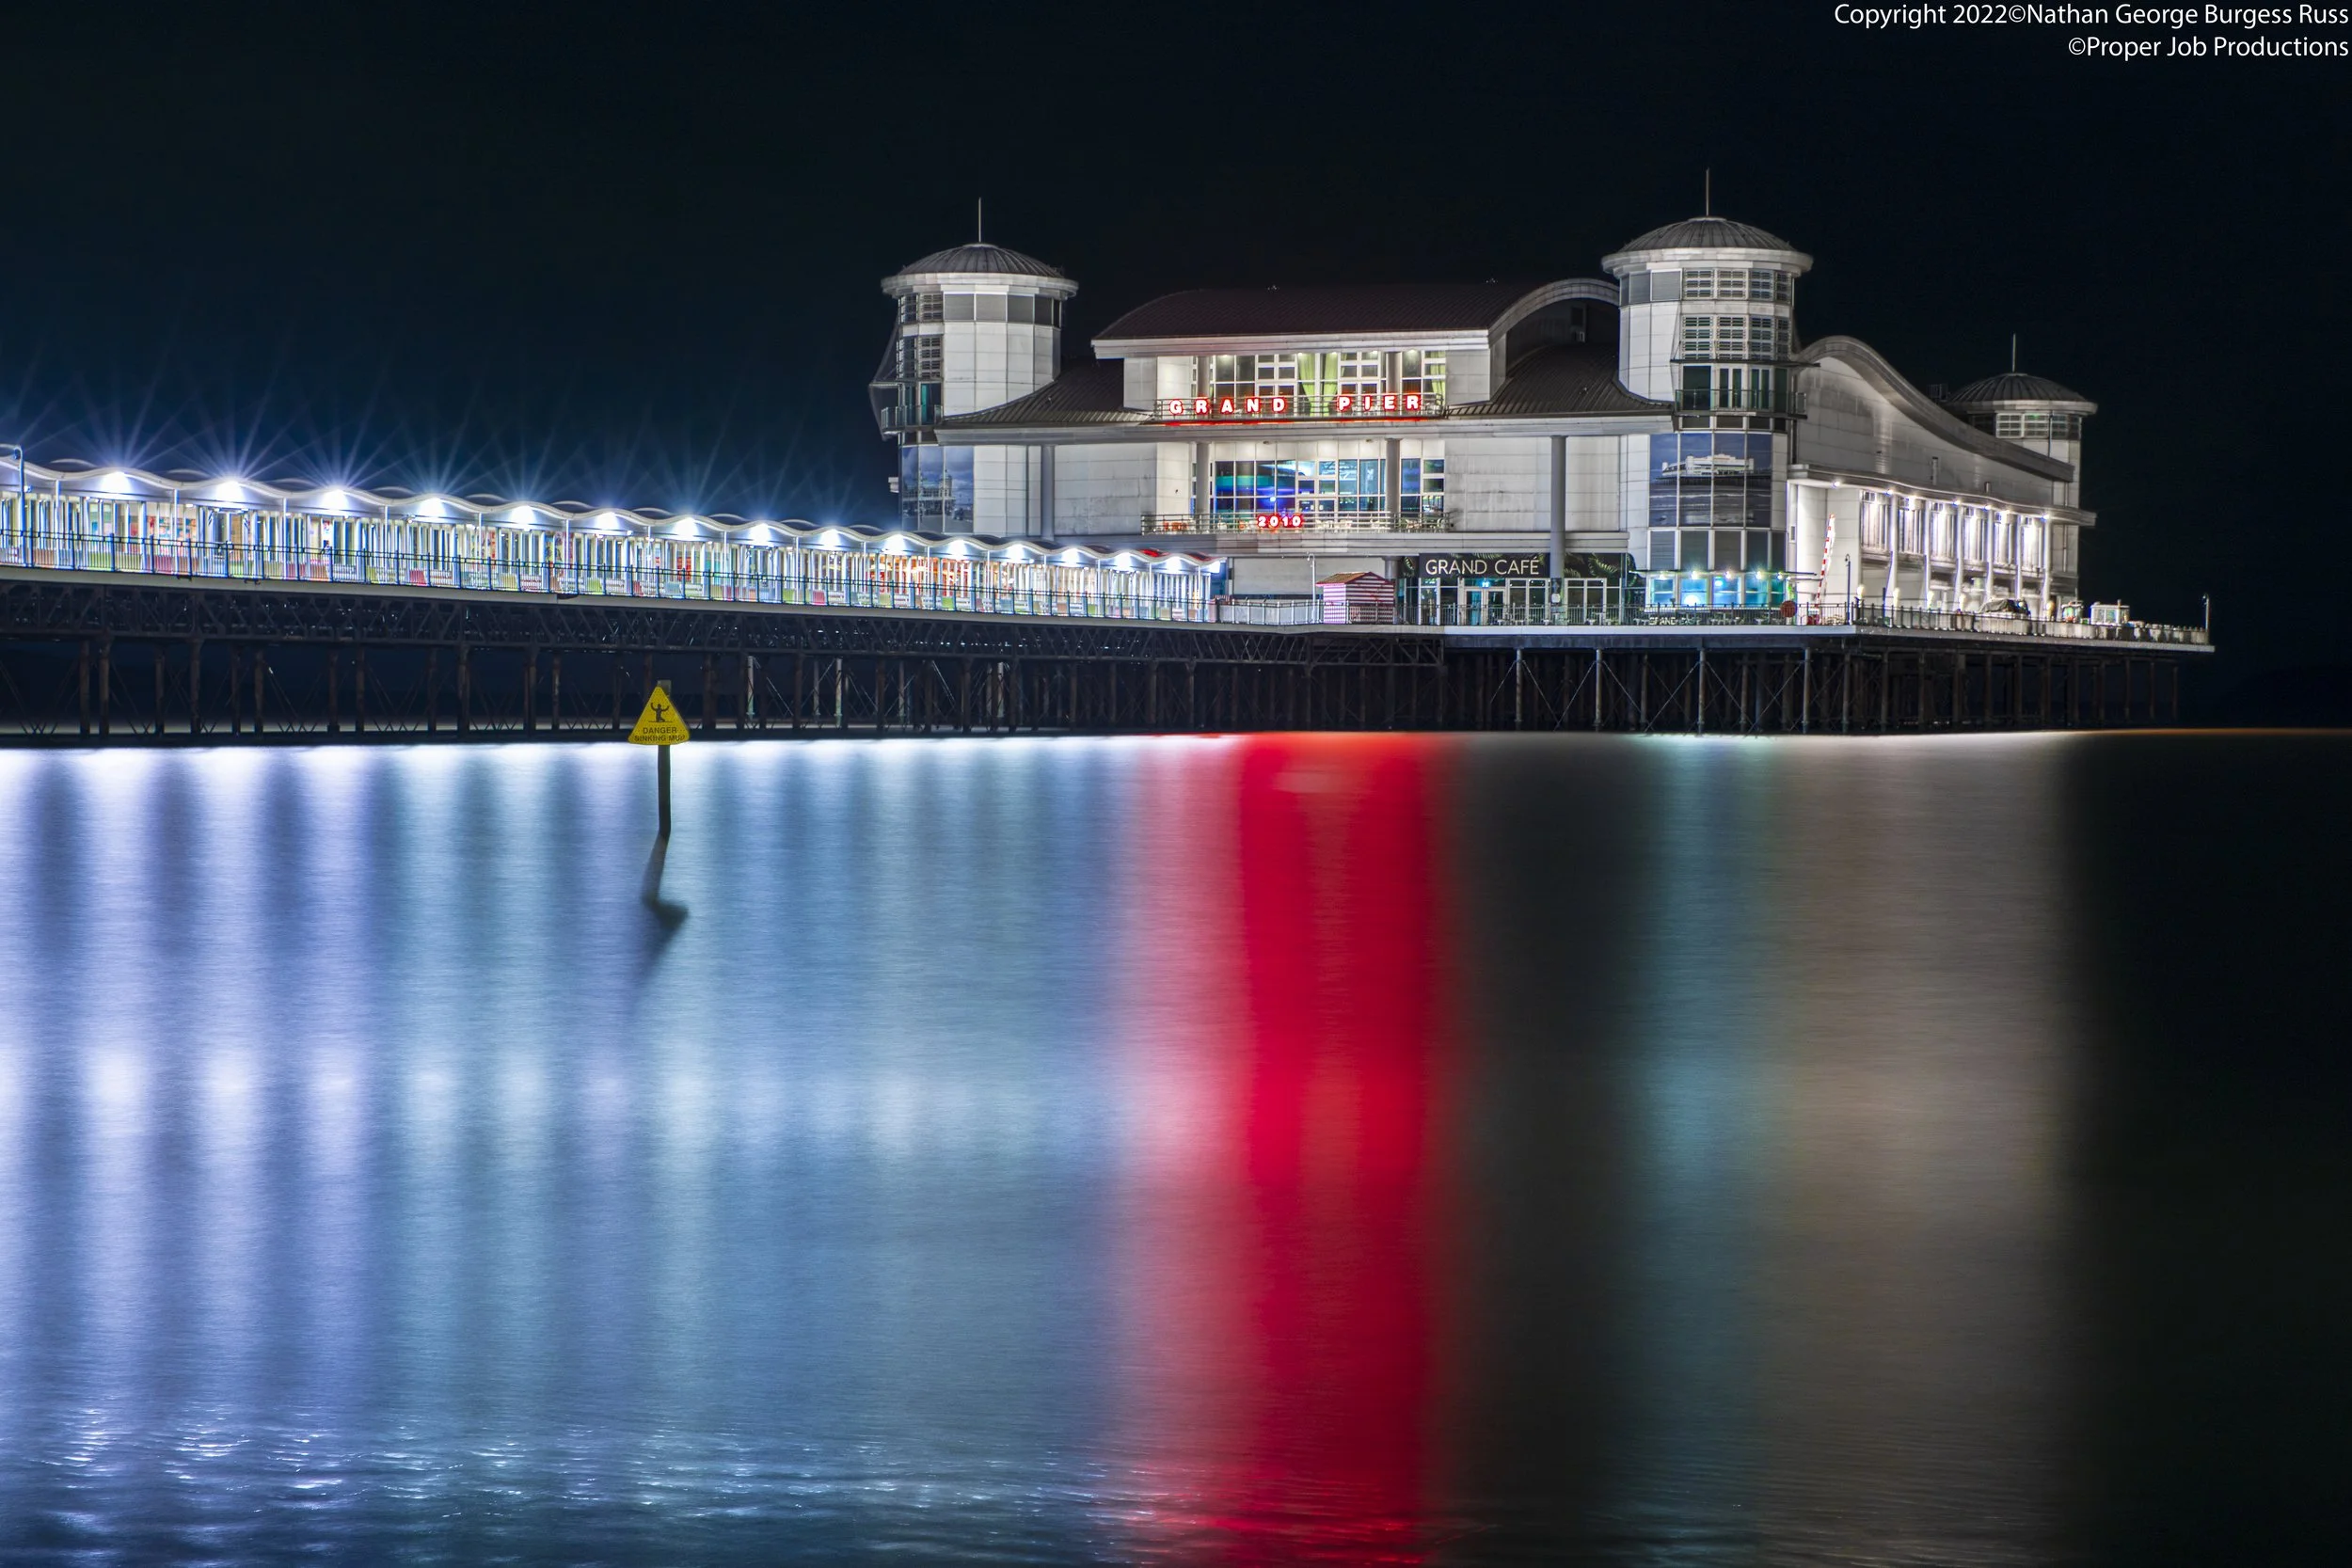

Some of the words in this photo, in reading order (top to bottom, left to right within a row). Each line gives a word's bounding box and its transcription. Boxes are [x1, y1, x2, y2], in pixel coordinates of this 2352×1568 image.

[1168, 397, 1287, 415] GRAND
[1337, 394, 1422, 412] PIER
[1257, 515, 1302, 528] 2010
[1424, 559, 1488, 575] GRAND
[1493, 556, 1540, 575] CAFÉ
[643, 726, 677, 735] DANGER
[634, 734, 667, 742] SINKING
